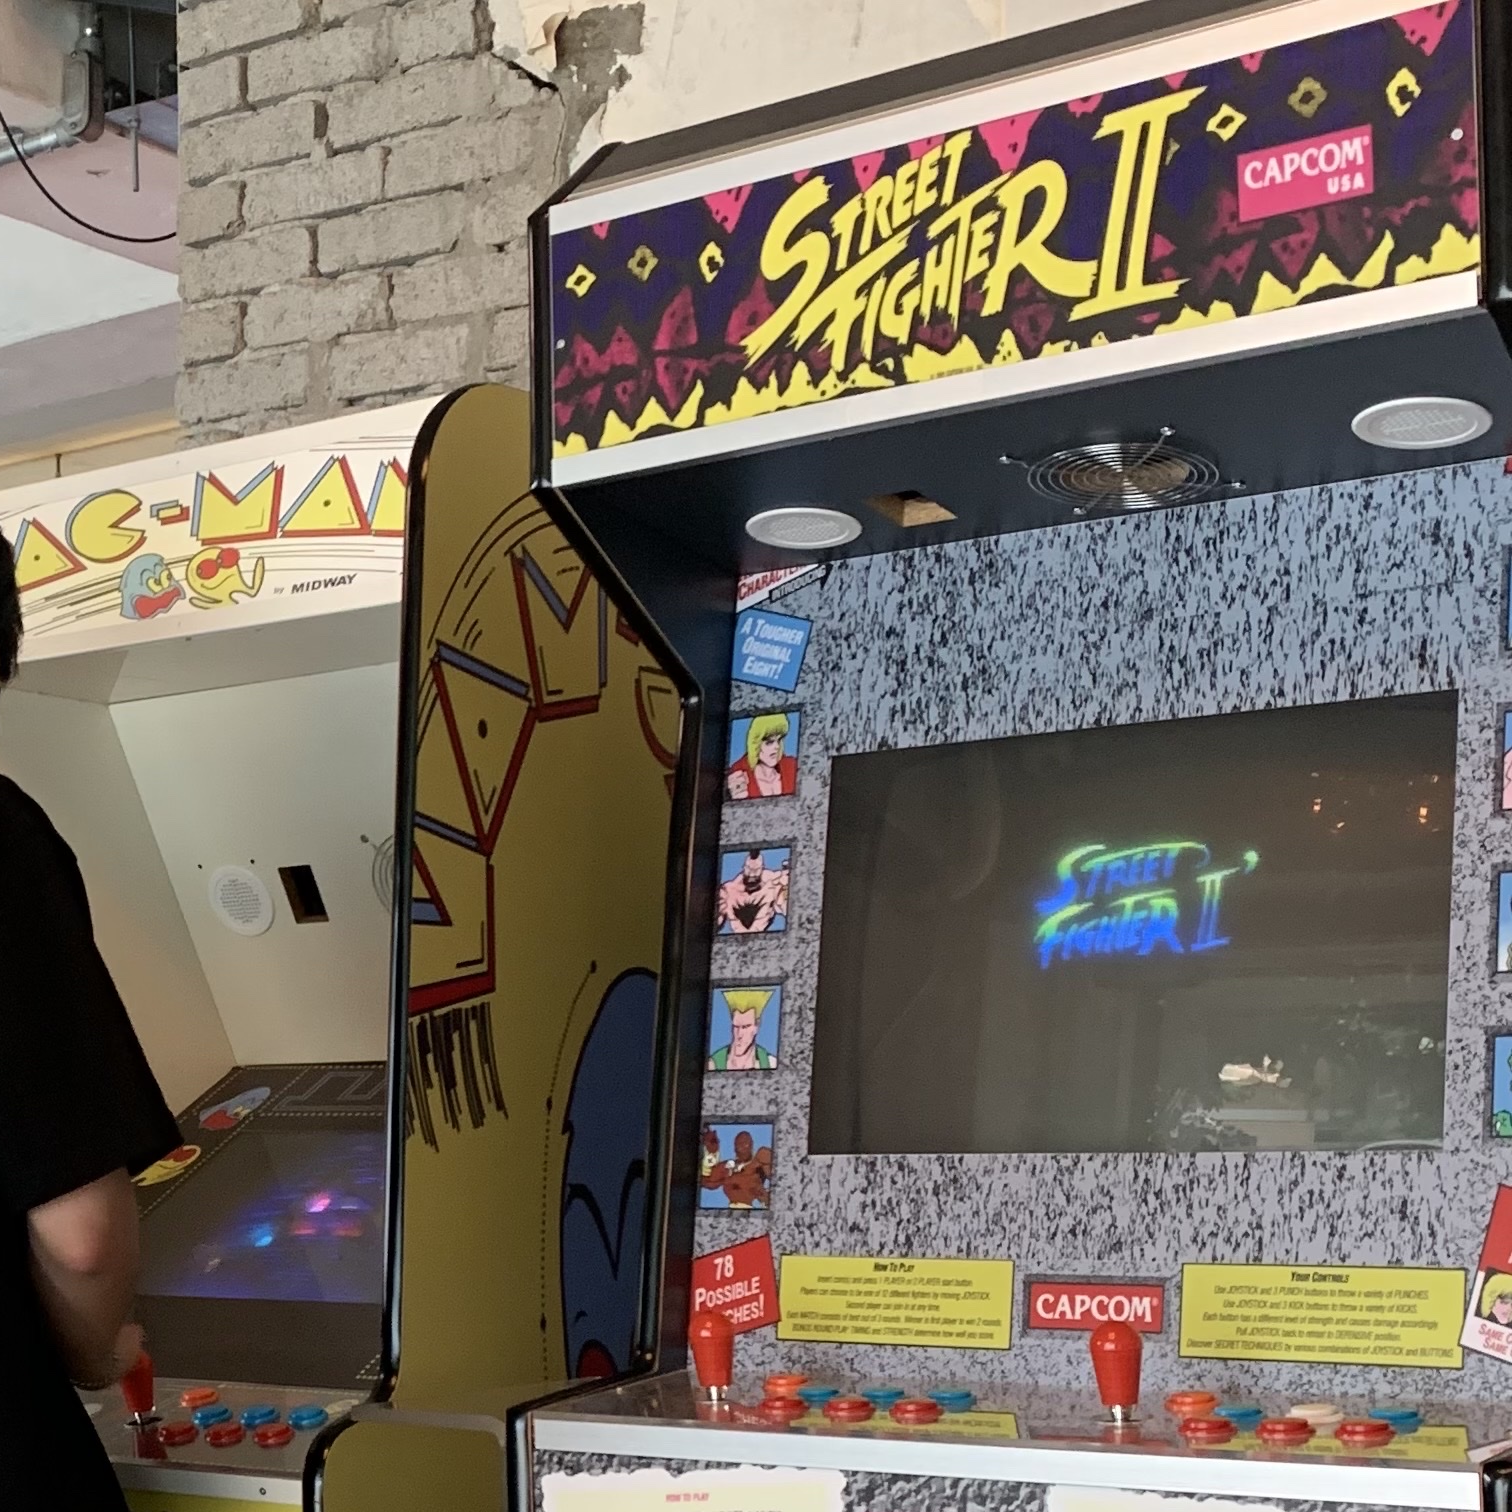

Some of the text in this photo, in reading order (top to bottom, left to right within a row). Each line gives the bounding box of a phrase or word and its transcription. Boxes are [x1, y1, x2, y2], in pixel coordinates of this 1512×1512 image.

[1244, 137, 1365, 189] CAPCOM
[1327, 172, 1365, 194] USA
[788, 86, 1207, 372] FIGHTER II
[740, 130, 972, 369] STREET
[291, 573, 357, 595] MIDWAY
[740, 617, 805, 645] A TOUGHER
[742, 637, 792, 663] ORIGINAL
[742, 656, 785, 680] EIGHT!
[713, 1254, 734, 1281] 78
[1290, 1271, 1349, 1283] YOUR CONTROLS
[694, 1276, 761, 1312] POSSIBLE
[1036, 1293, 1153, 1322] CAPCOM
